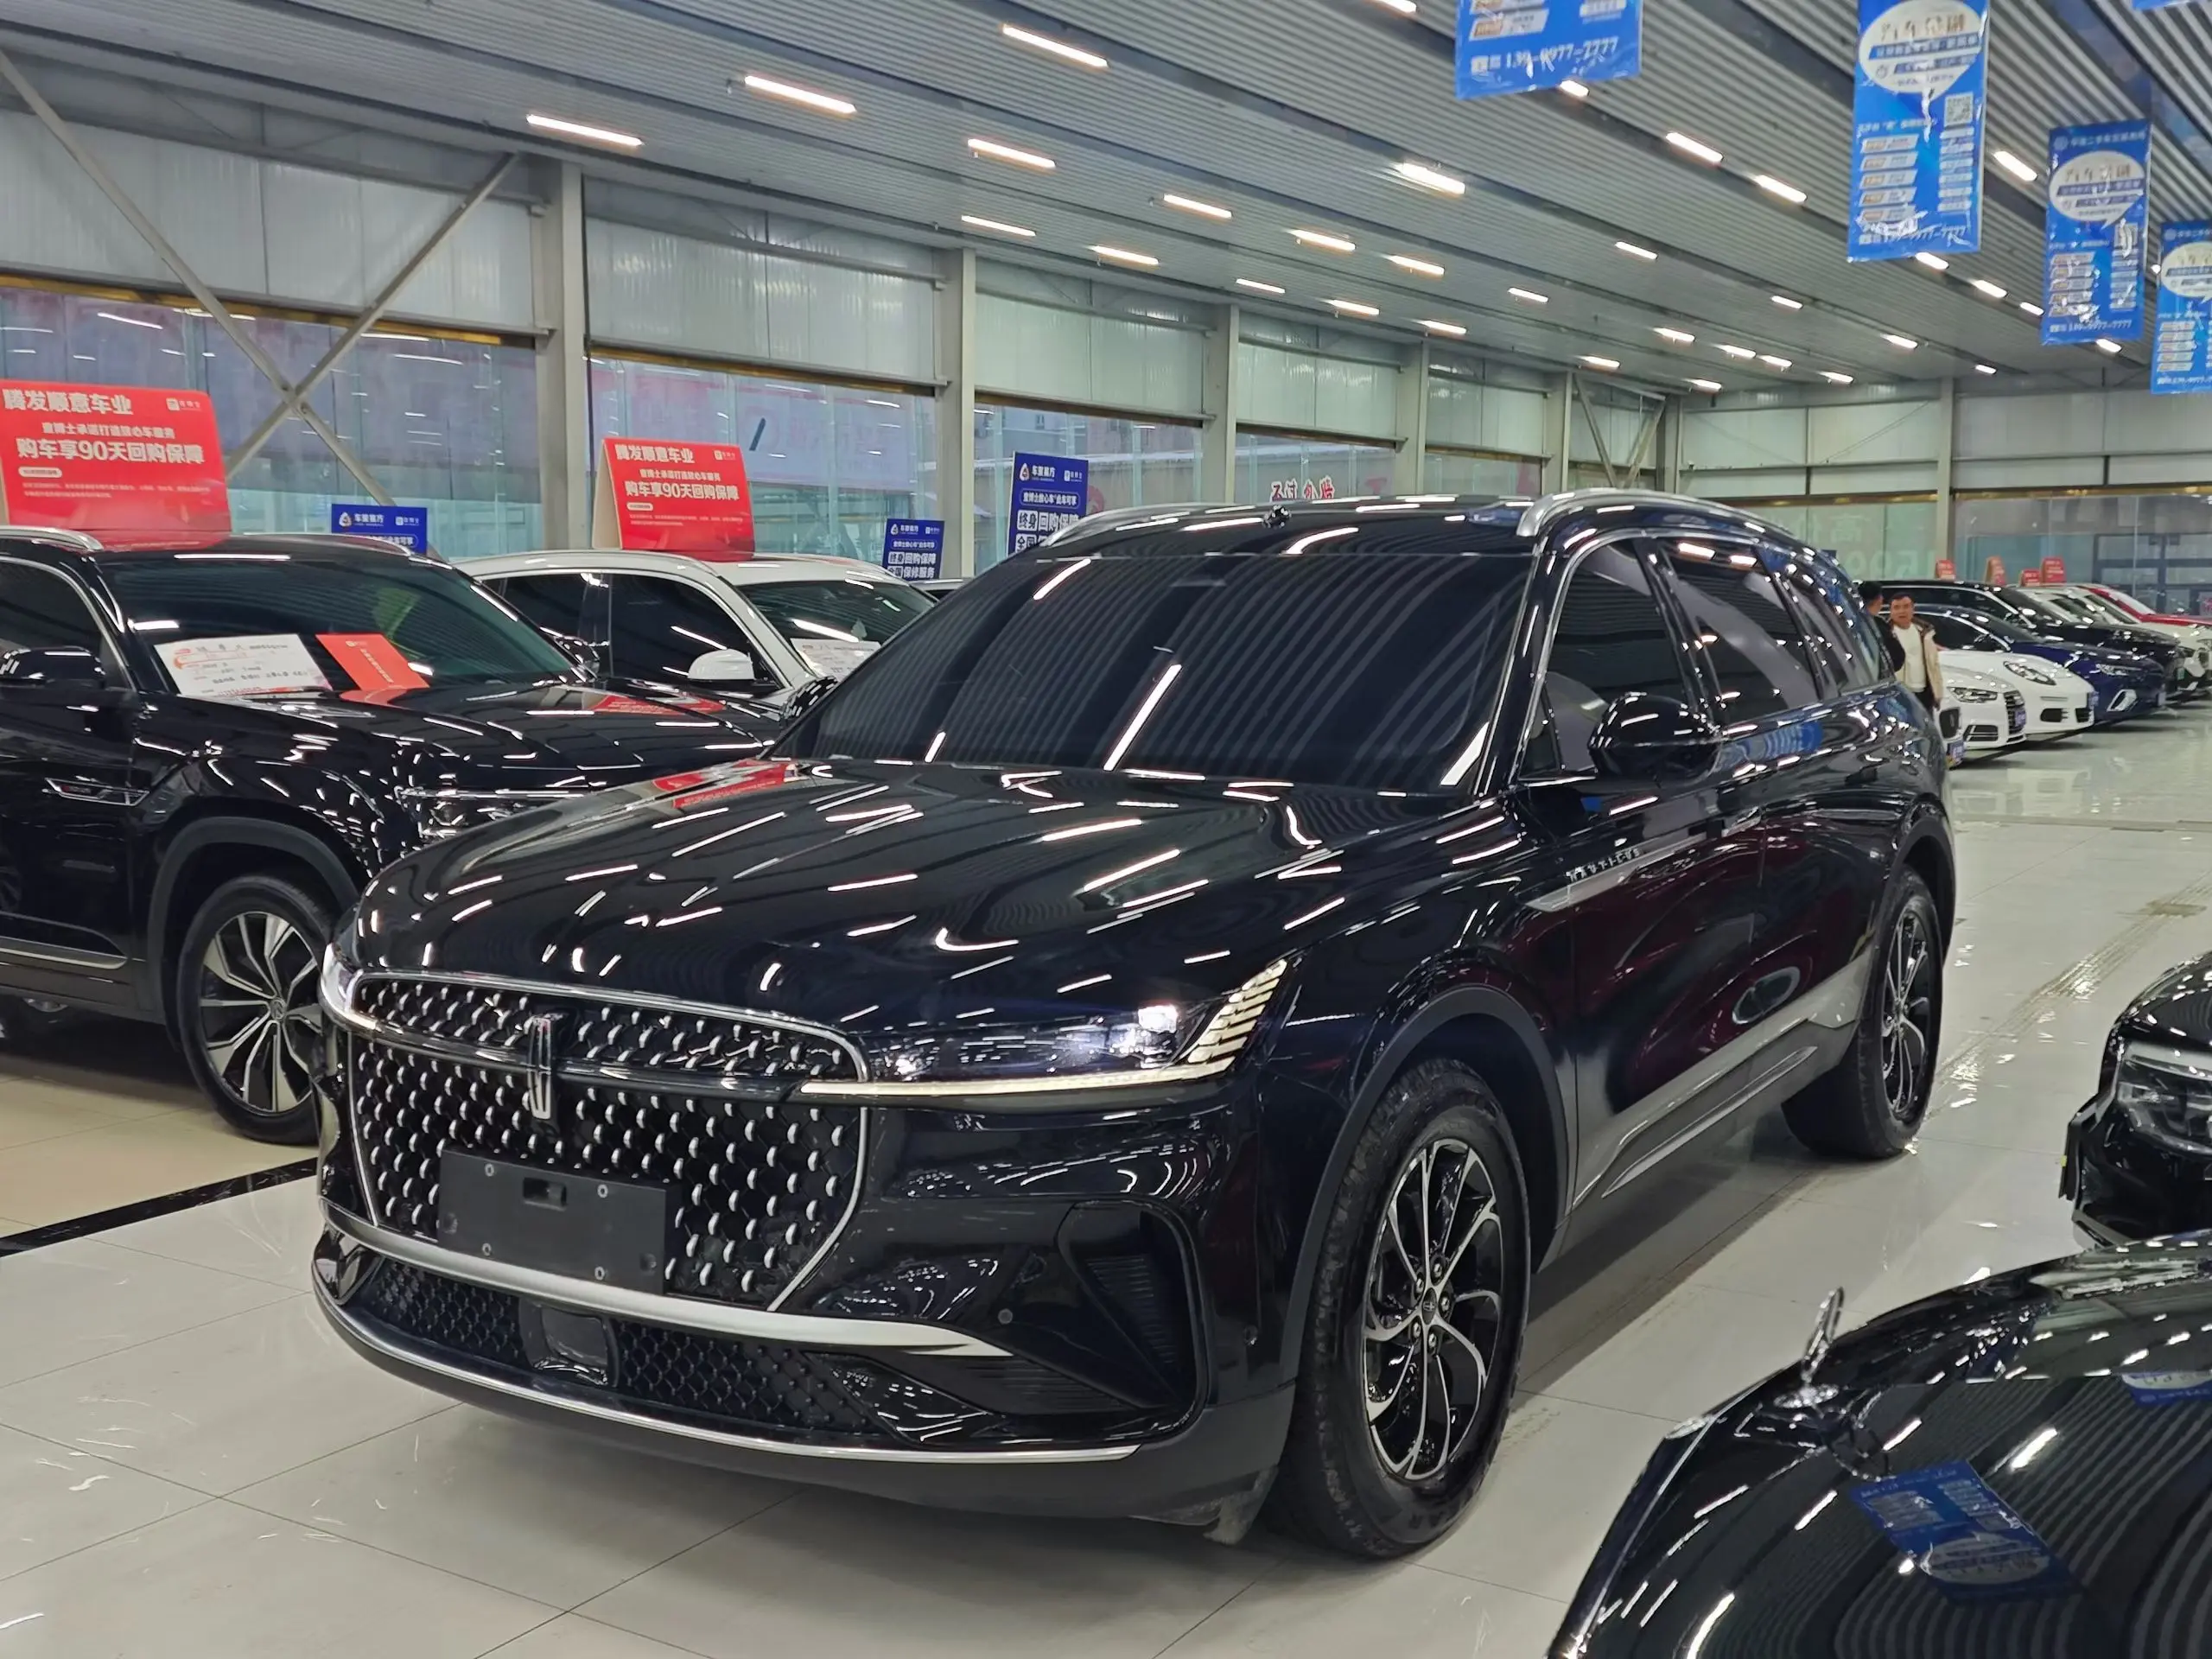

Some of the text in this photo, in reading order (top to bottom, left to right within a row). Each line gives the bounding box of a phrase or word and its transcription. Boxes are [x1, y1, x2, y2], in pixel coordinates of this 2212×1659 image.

[16, 438, 205, 464] 购车享90天回购保障
[625, 481, 740, 500] 购车享90天回购保障
